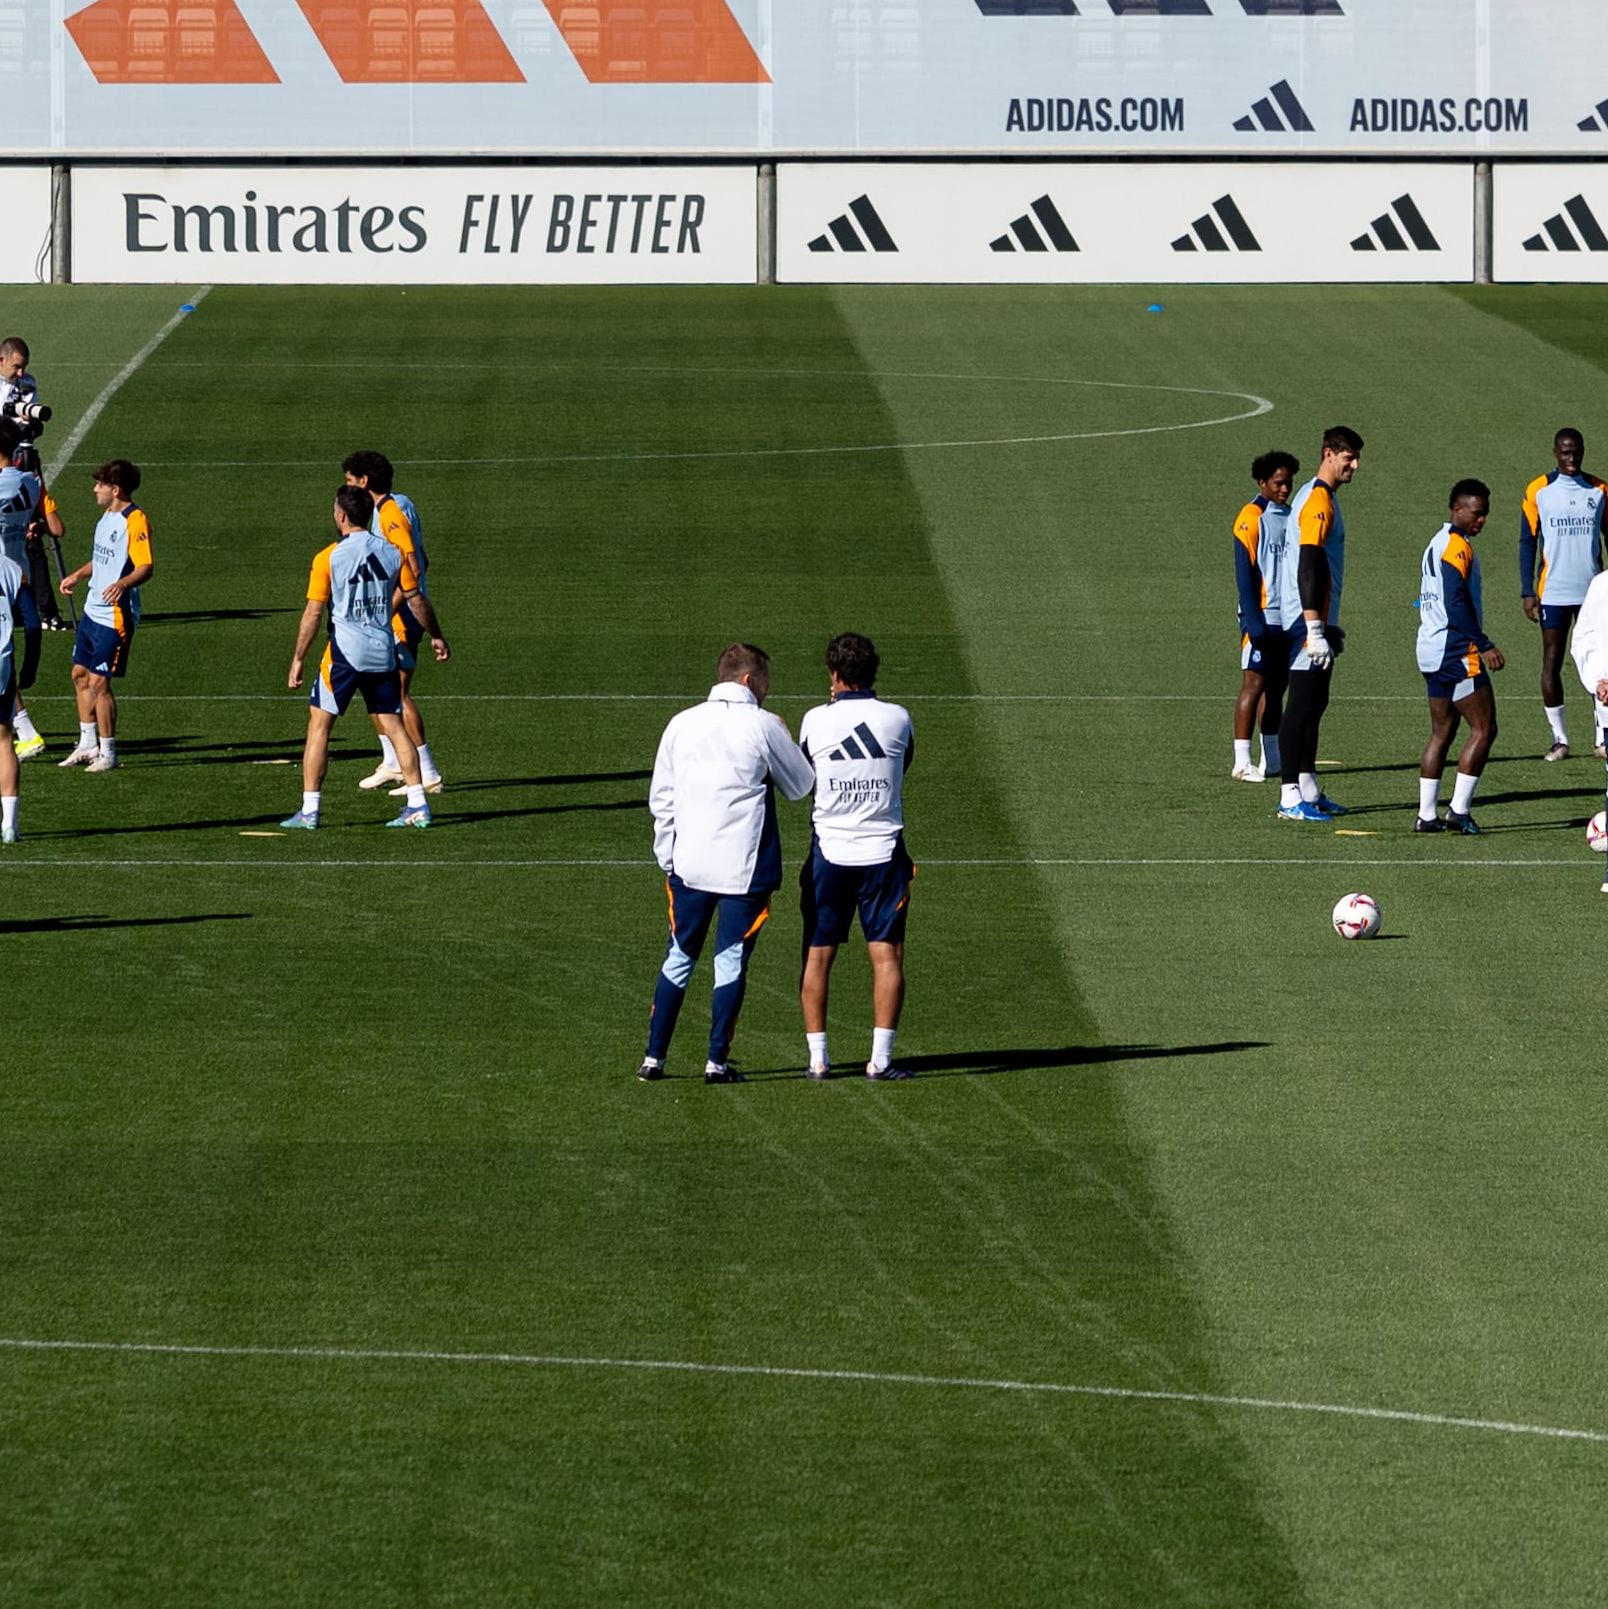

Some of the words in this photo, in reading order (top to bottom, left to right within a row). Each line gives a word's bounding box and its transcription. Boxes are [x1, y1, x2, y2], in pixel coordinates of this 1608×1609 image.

[1007, 98, 1185, 133] ADIDAS.COM
[1351, 98, 1529, 133] ADIDAS.COM
[122, 191, 427, 254] Emirates
[460, 195, 534, 254] FLY
[547, 195, 706, 255] BETTER
[1550, 516, 1596, 528] Emirates
[830, 777, 890, 791] Emirates
